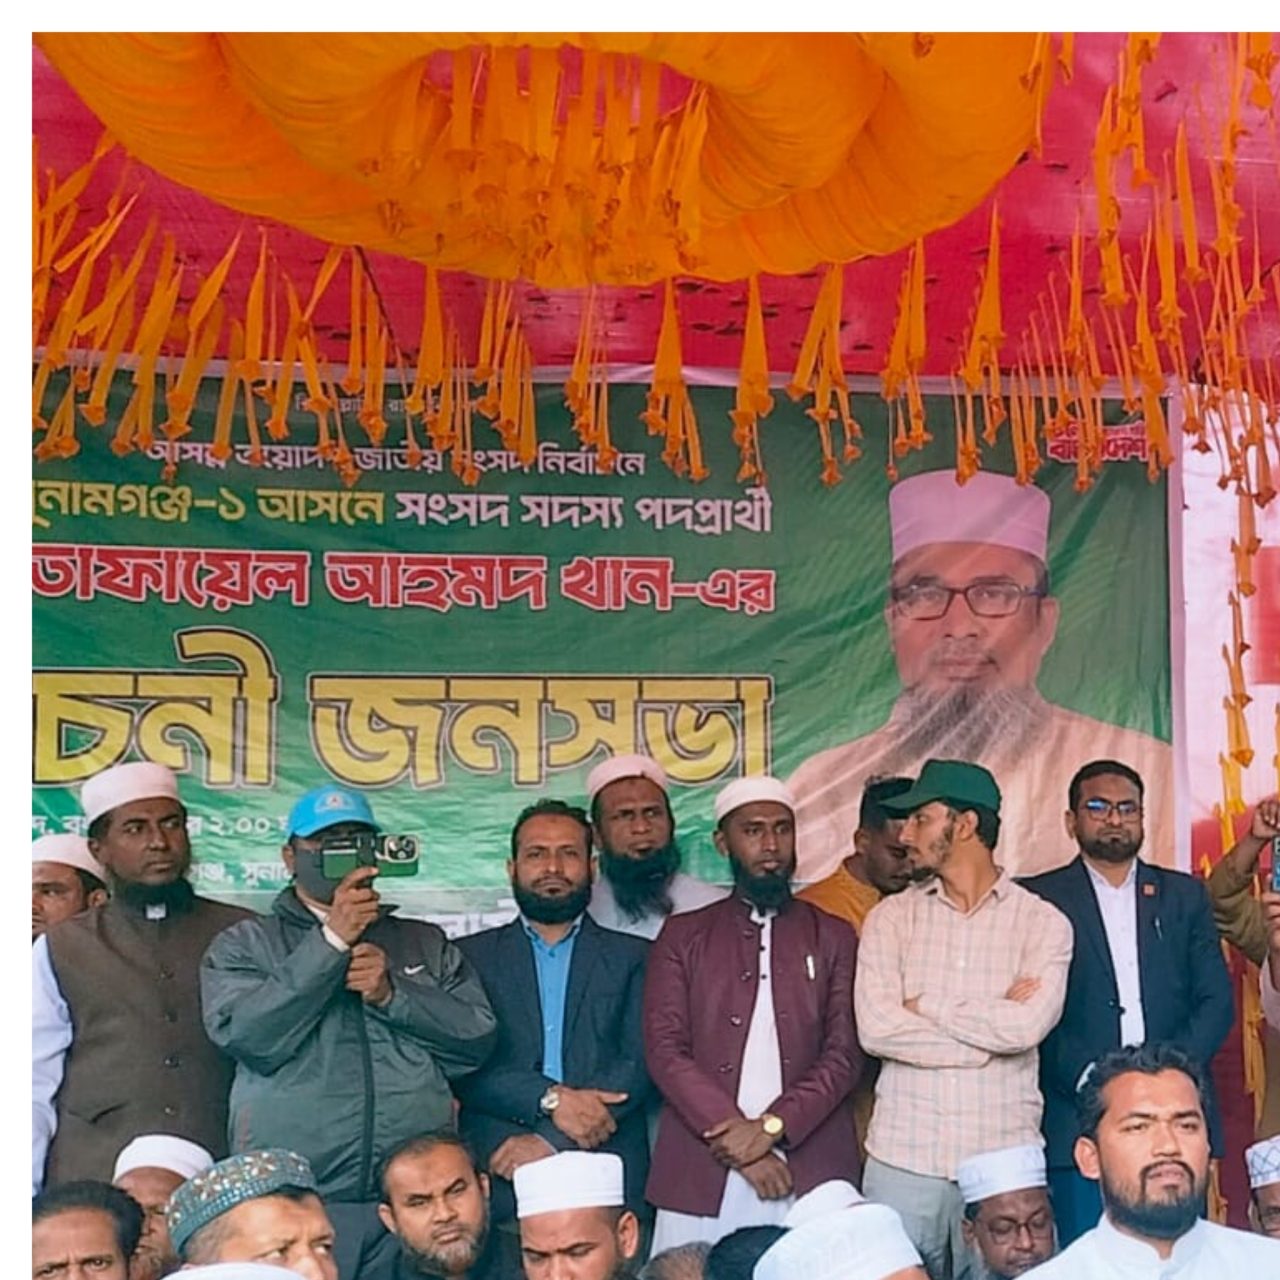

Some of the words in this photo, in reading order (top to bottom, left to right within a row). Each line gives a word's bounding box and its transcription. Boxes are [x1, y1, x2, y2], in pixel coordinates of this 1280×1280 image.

[453, 450, 531, 474] ংসদ
[537, 441, 646, 477] নির্বানে
[32, 480, 247, 528] ুনামগঞ্জ-১
[256, 487, 385, 525] আসনে
[395, 492, 510, 529] সংসদ
[519, 494, 624, 530] সদস্য
[635, 485, 773, 535] পদপ্রার্থী
[32, 543, 310, 611] তাফায়েল
[323, 551, 548, 613] আহমদ
[560, 555, 777, 617] খান-এর
[305, 671, 774, 791] জনসভা
